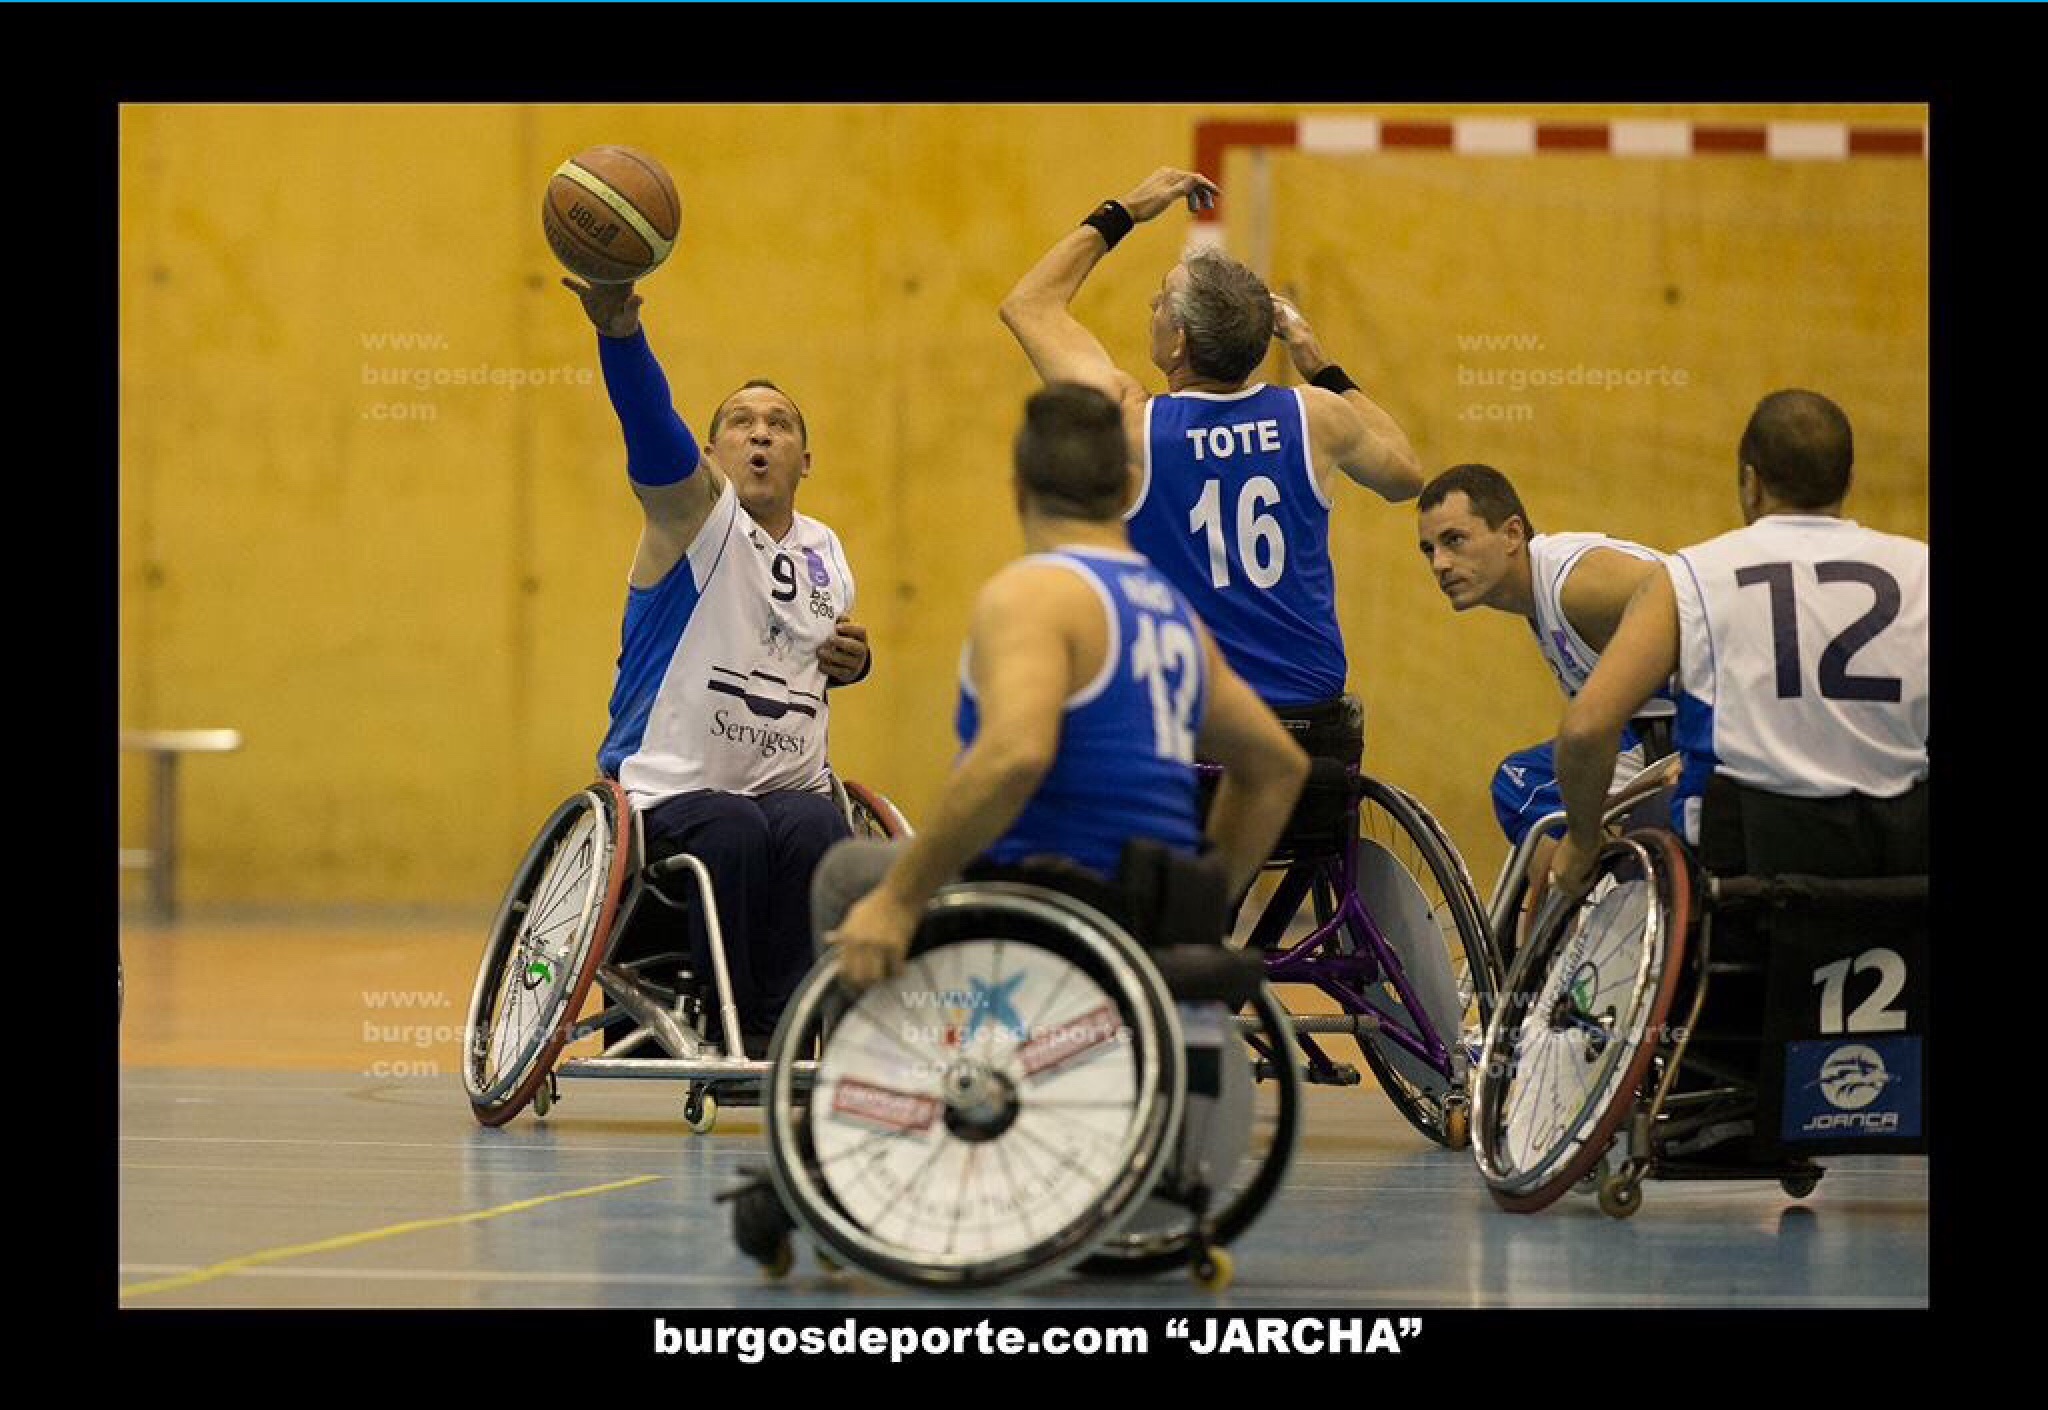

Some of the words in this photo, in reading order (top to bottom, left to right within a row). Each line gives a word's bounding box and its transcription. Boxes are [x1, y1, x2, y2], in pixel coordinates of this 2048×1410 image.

[1186, 420, 1281, 461] TOTE
[1190, 476, 1285, 589] 16
[772, 553, 798, 602] 9
[1734, 560, 1903, 704] 12
[1131, 614, 1198, 764] 12
[710, 709, 805, 758] Servigest
[1813, 948, 1907, 1034] 12
